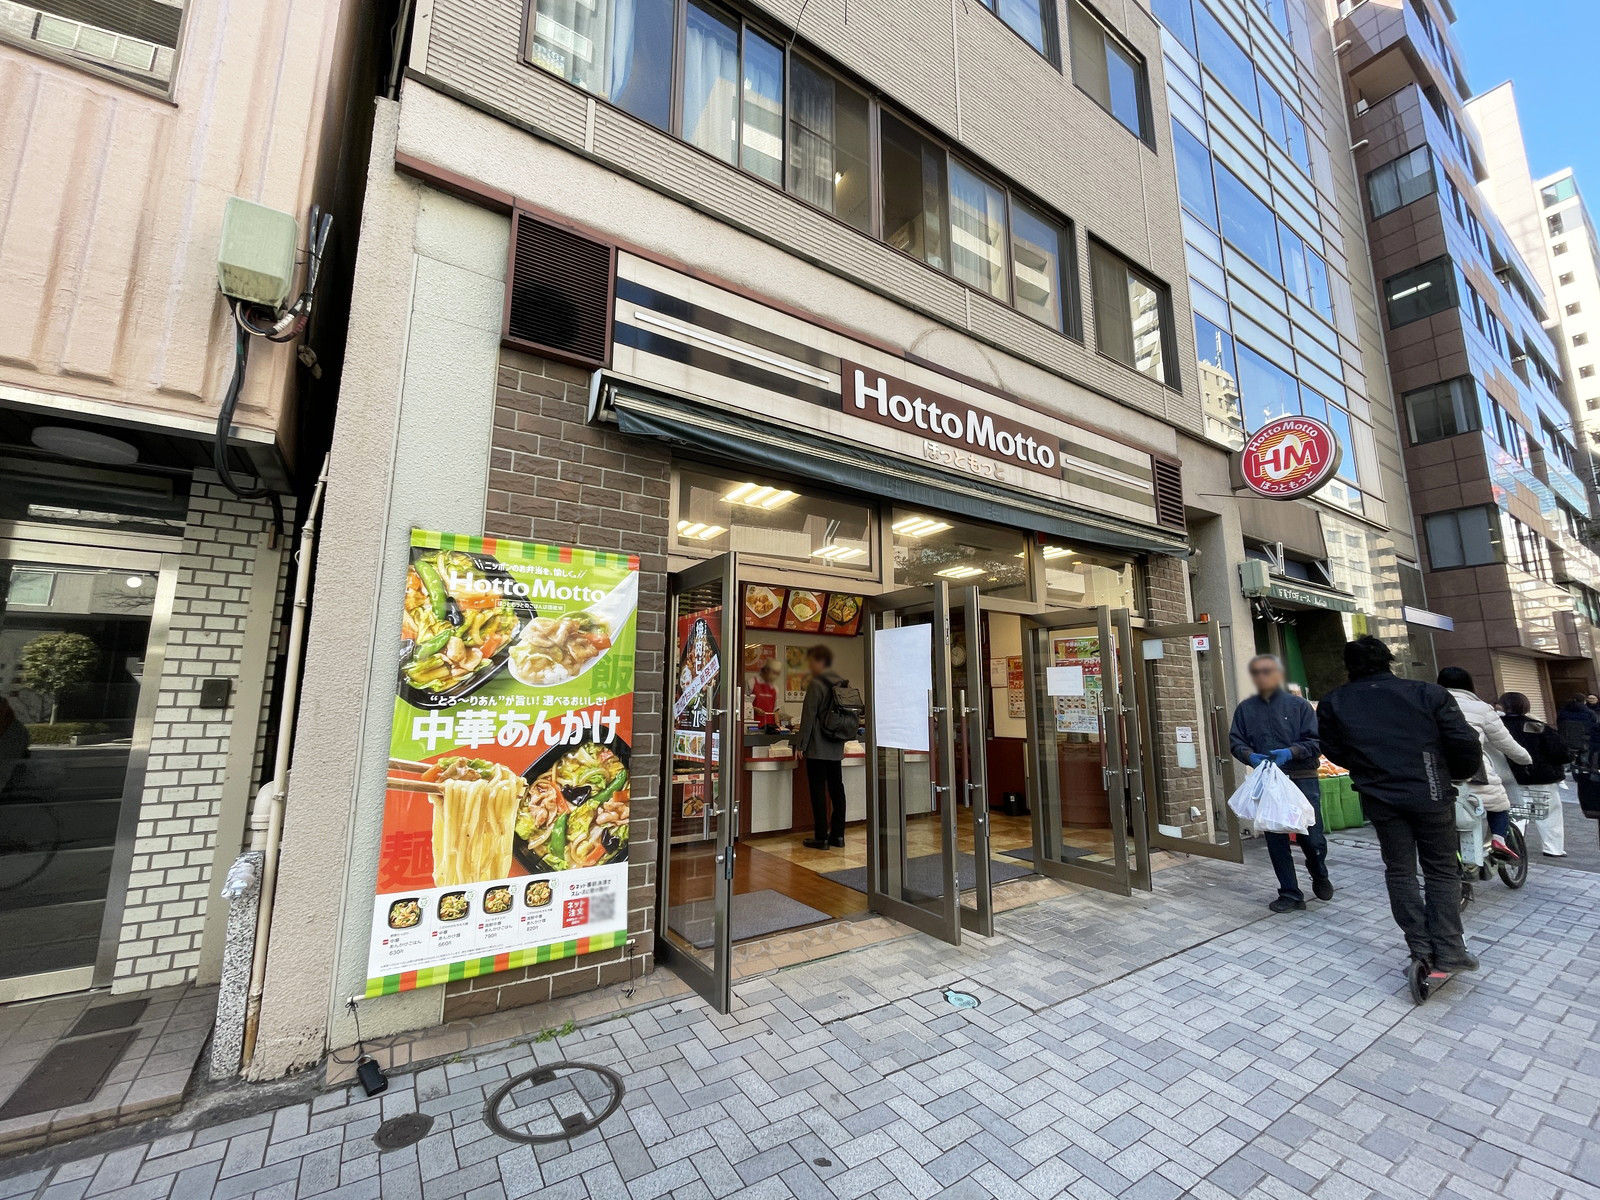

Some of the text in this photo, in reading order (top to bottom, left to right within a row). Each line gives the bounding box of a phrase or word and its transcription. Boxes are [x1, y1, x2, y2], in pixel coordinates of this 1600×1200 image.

[854, 369, 1056, 469] Hotto Motto
[1249, 421, 1318, 452] Hotto Motto
[923, 440, 1005, 481] ほっともっと
[1252, 438, 1320, 477] HM
[1260, 471, 1316, 492] ほっともっと
[450, 571, 607, 603] Hotto Motto
[589, 654, 633, 698] 飯
[411, 709, 621, 751] 中華あんかけ
[379, 830, 435, 890] 麺
